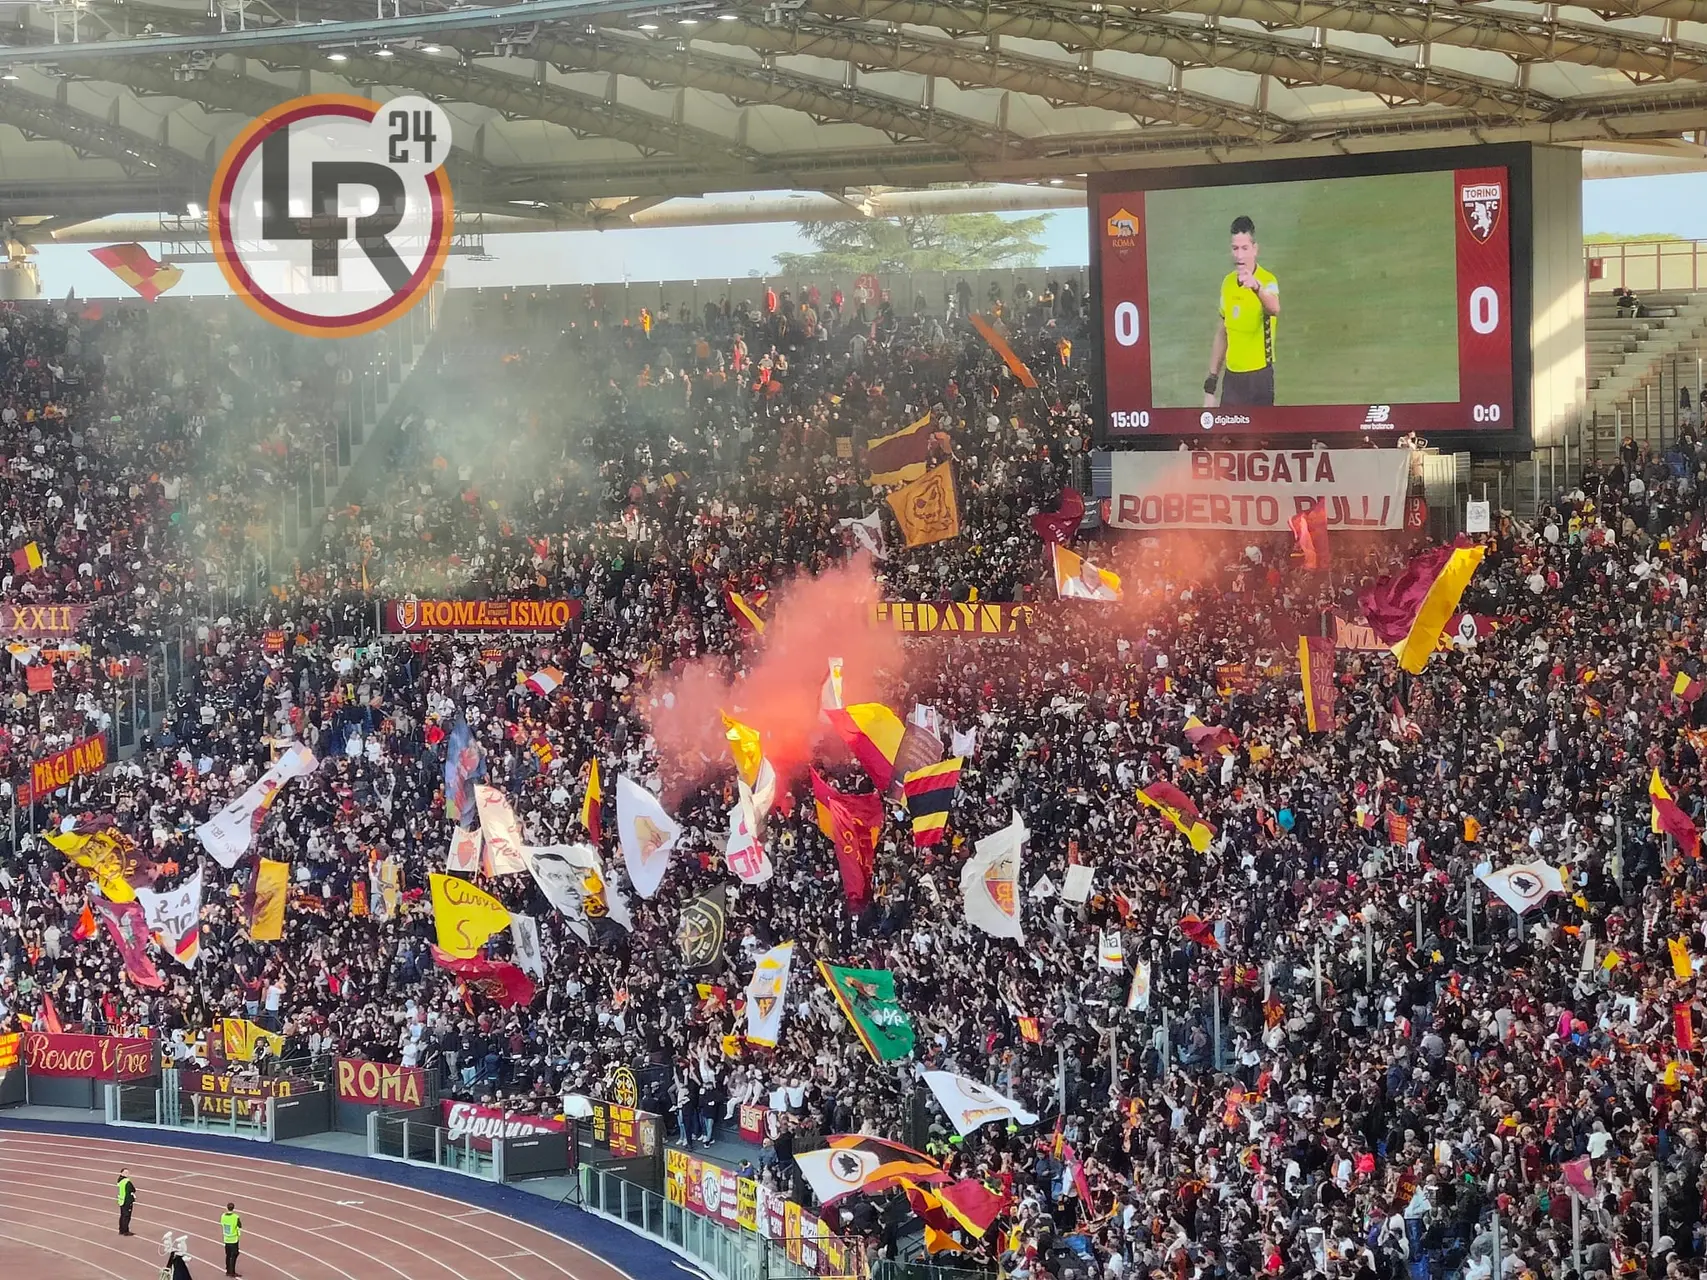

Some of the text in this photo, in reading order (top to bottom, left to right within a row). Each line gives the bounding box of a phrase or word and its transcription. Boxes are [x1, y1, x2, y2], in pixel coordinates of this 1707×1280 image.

[1465, 188, 1497, 198] TORINO
[1486, 201, 1498, 210] FC
[1112, 238, 1135, 247] ROMA
[1469, 286, 1499, 334] 0
[1114, 301, 1139, 346] 0
[1111, 411, 1149, 428] 15:00
[1215, 415, 1250, 426] digitalbits
[1473, 404, 1500, 422] 0:0
[1192, 451, 1335, 483] BRIGATA
[1118, 493, 1279, 526] ROBERTO
[11, 606, 72, 631] XXII
[34, 738, 105, 793] MAGLIANA
[338, 1060, 420, 1107] ROMA
